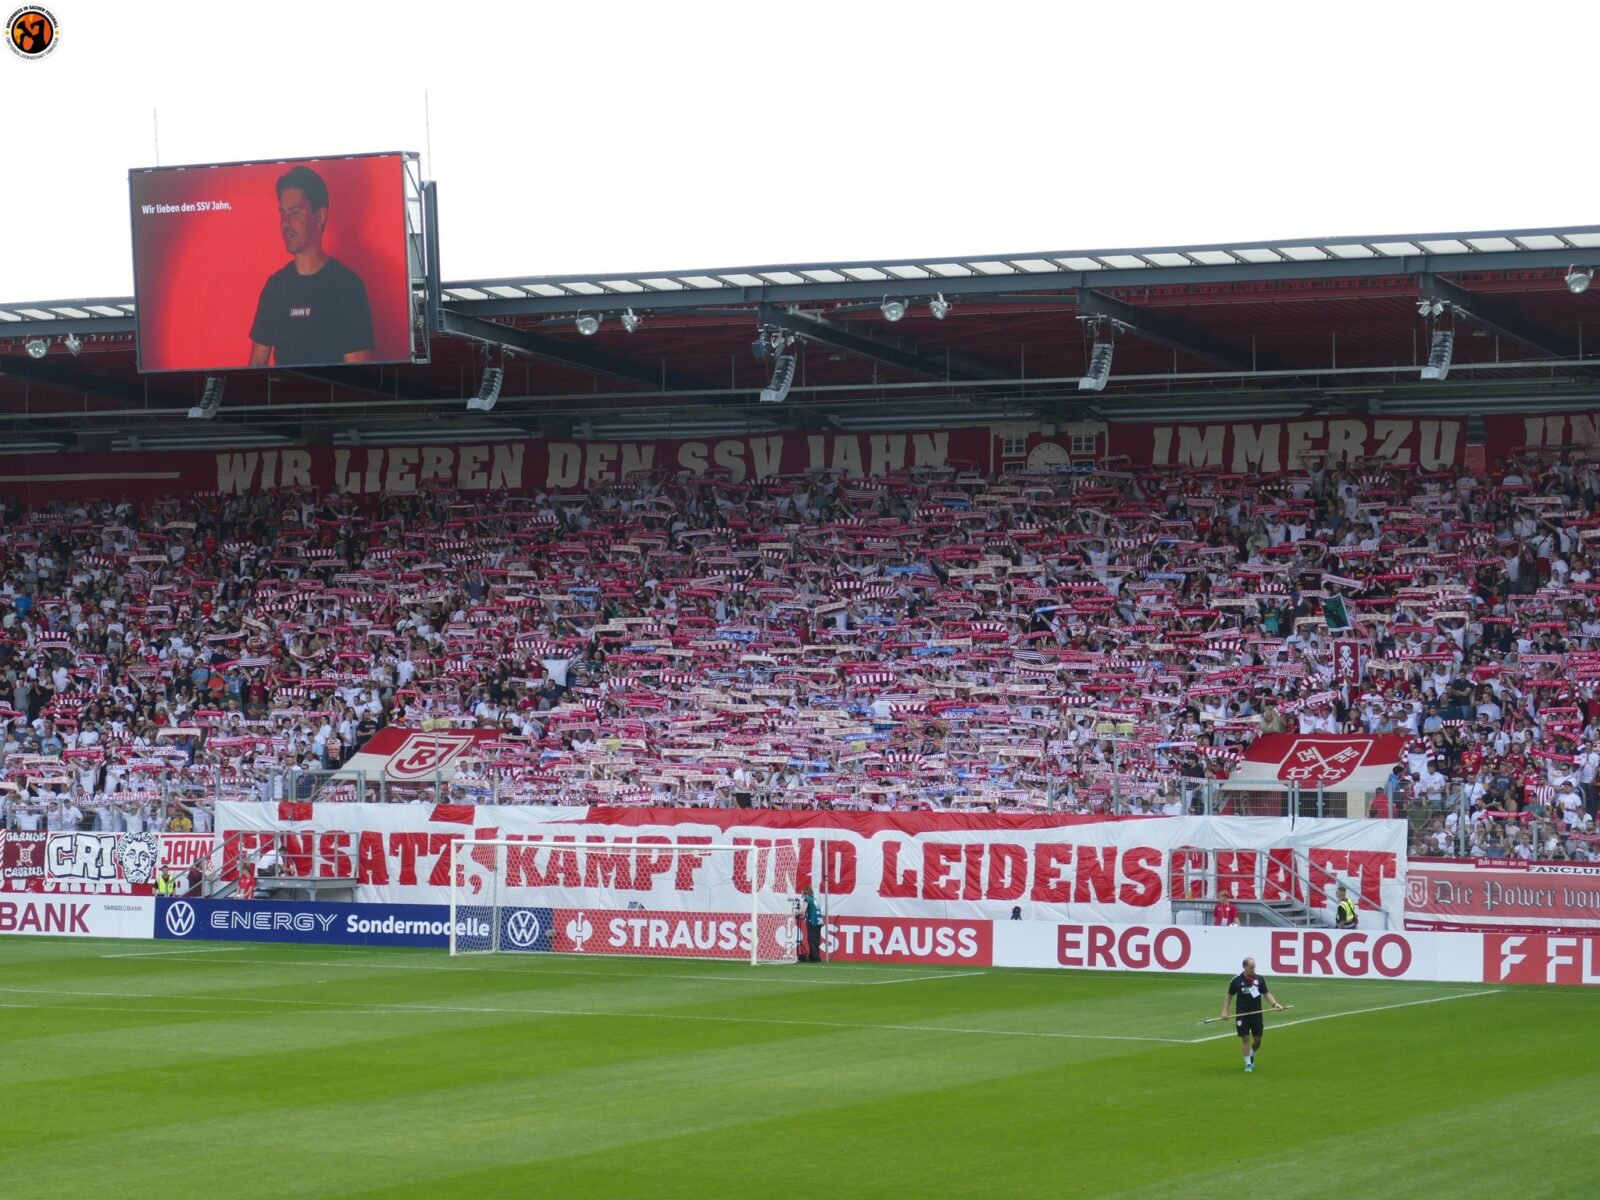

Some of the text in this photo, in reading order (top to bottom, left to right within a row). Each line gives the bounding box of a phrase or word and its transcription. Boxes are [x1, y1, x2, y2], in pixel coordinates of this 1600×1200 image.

[141, 200, 232, 214] Wir lieben den SSV Jahn,
[216, 449, 312, 495] WIR
[547, 441, 655, 488] DEN
[678, 435, 784, 484] SSV
[1153, 418, 1462, 472] IMMERZU
[161, 840, 214, 866] JAHN
[505, 833, 713, 892] KAMPF
[732, 836, 857, 895] UND
[876, 841, 1397, 911] LEIDENSCHAFT
[1433, 879, 1473, 905] Die
[1483, 878, 1557, 911] Power
[0, 902, 91, 933] BANK
[210, 910, 490, 937] ENERGY Sondermodelle
[608, 918, 758, 950] STRAUSS
[819, 921, 979, 958] STRAUSS
[1057, 924, 1192, 970] ERGO
[1271, 930, 1412, 978] ERGO
